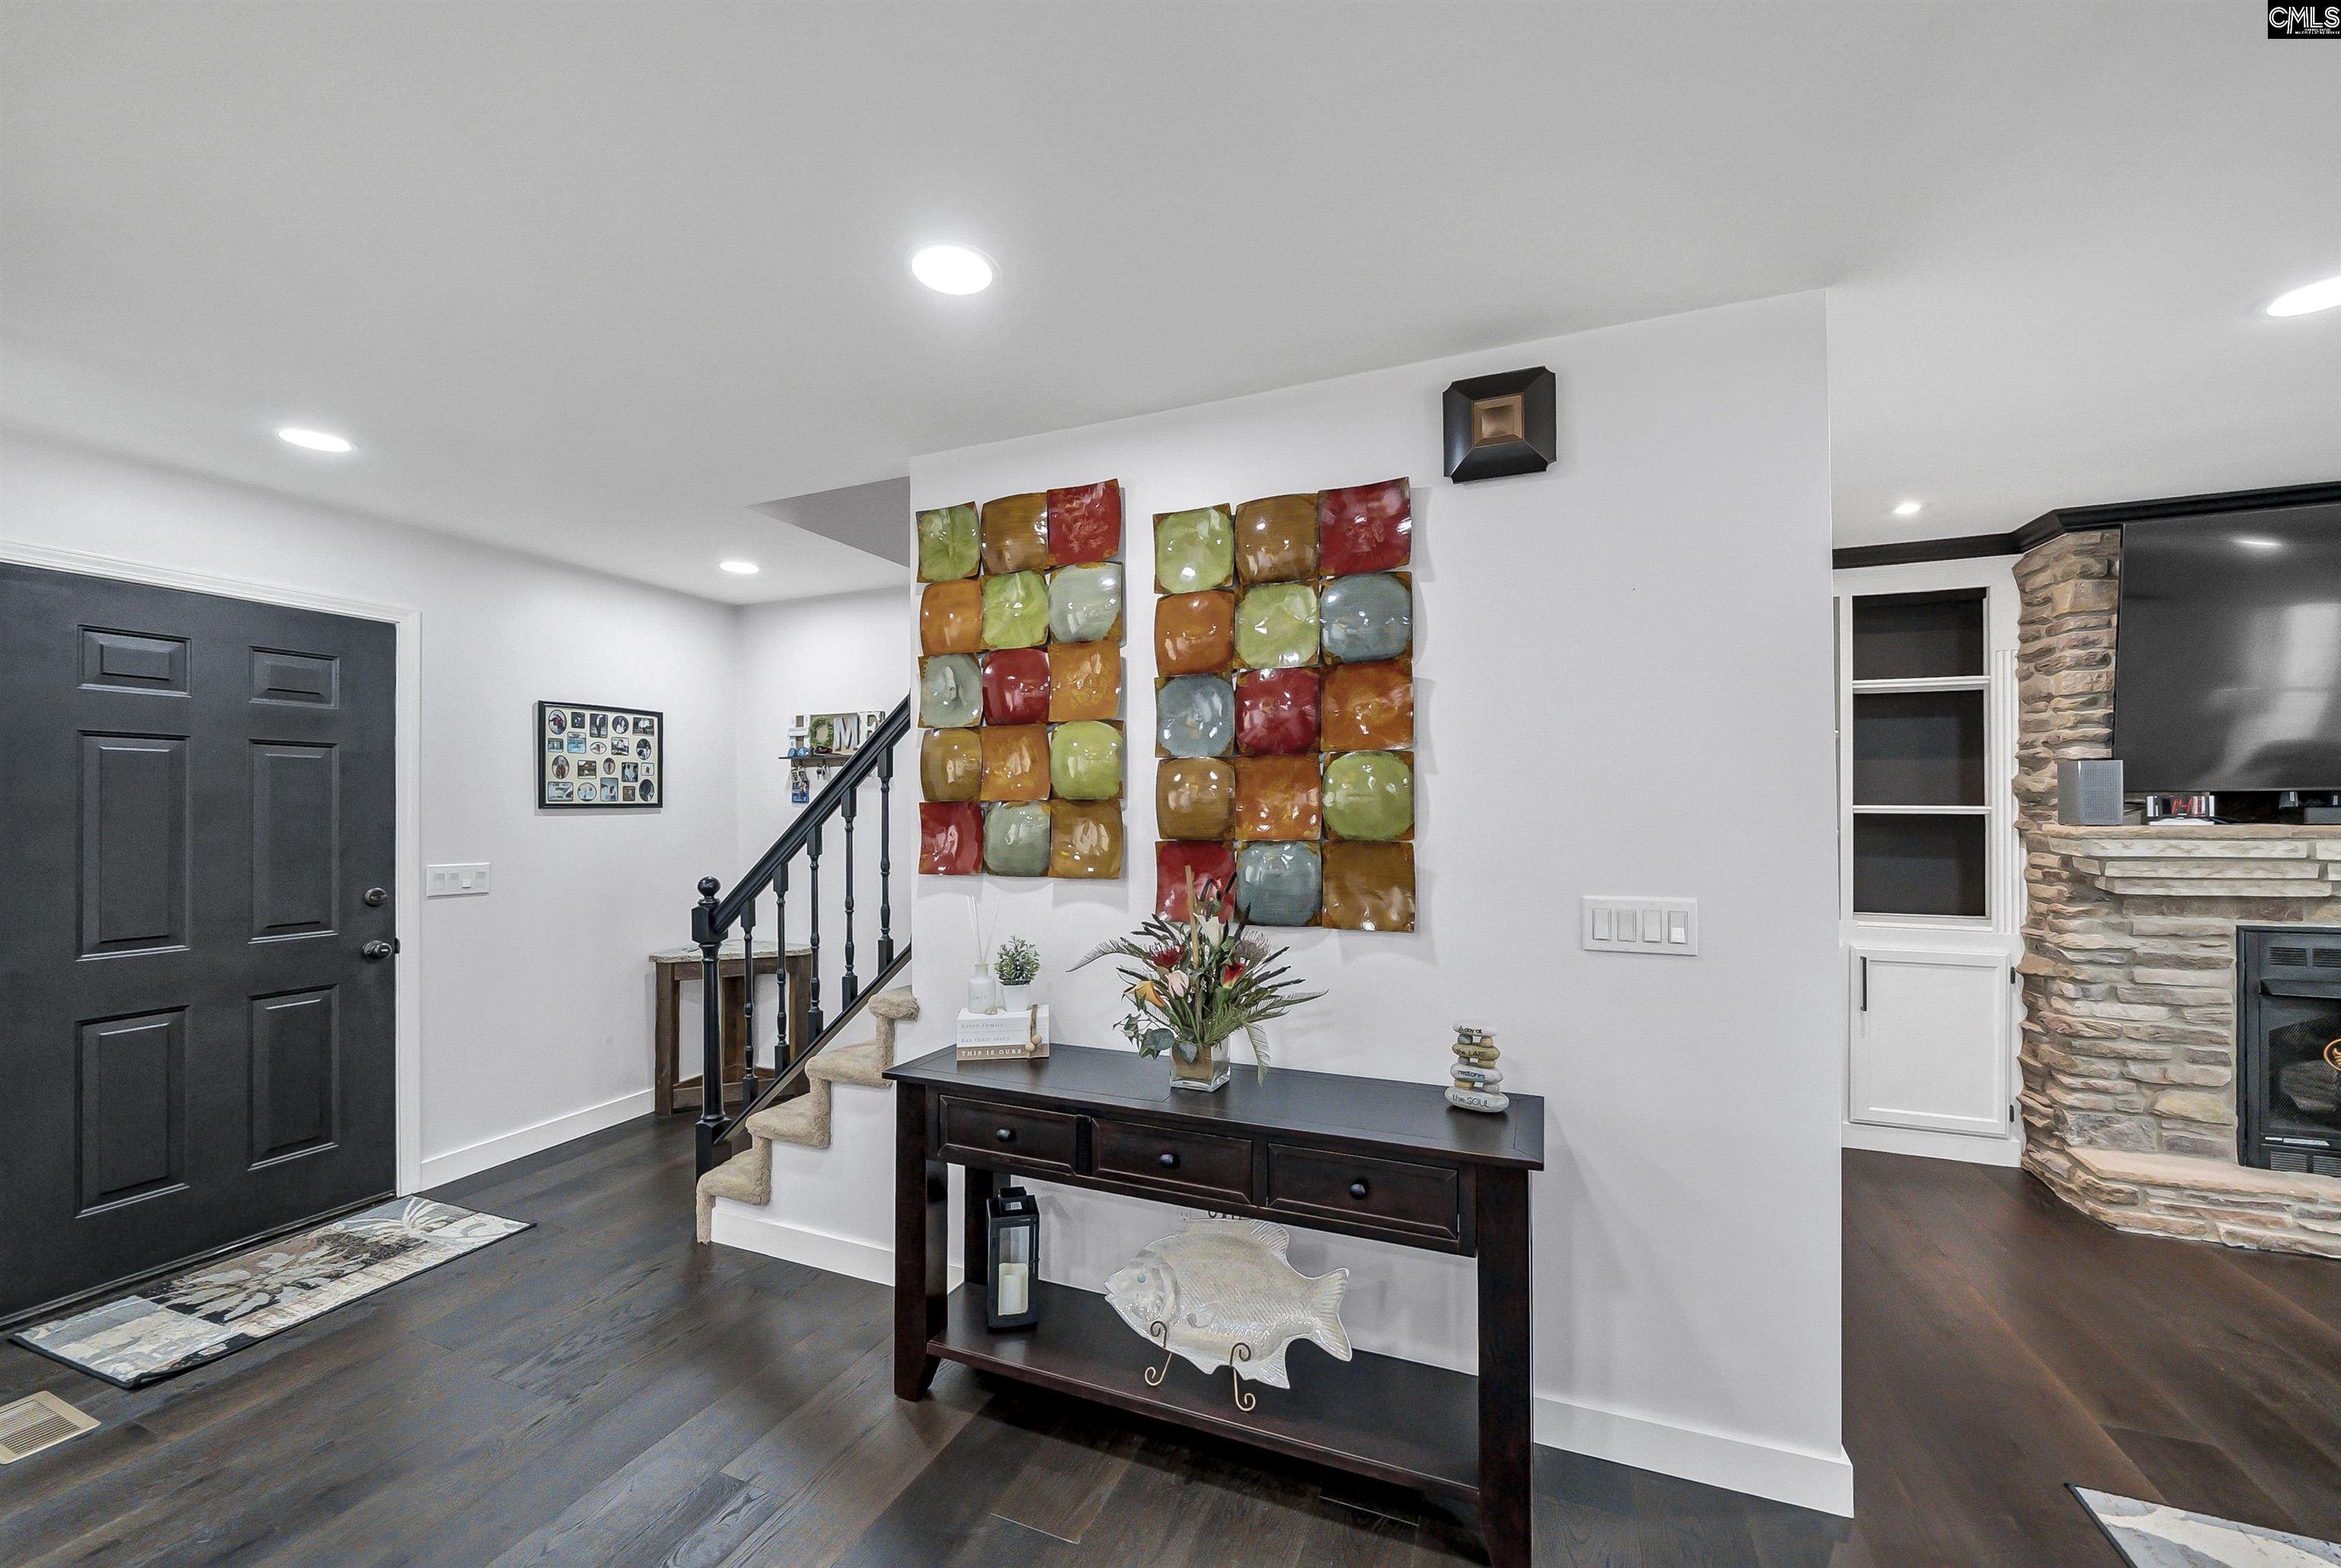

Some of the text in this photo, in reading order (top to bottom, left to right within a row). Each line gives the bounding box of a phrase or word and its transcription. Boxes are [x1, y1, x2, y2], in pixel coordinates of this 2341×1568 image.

[1458, 1070, 1486, 1080] restores
[1452, 1094, 1491, 1109] the SOUL
